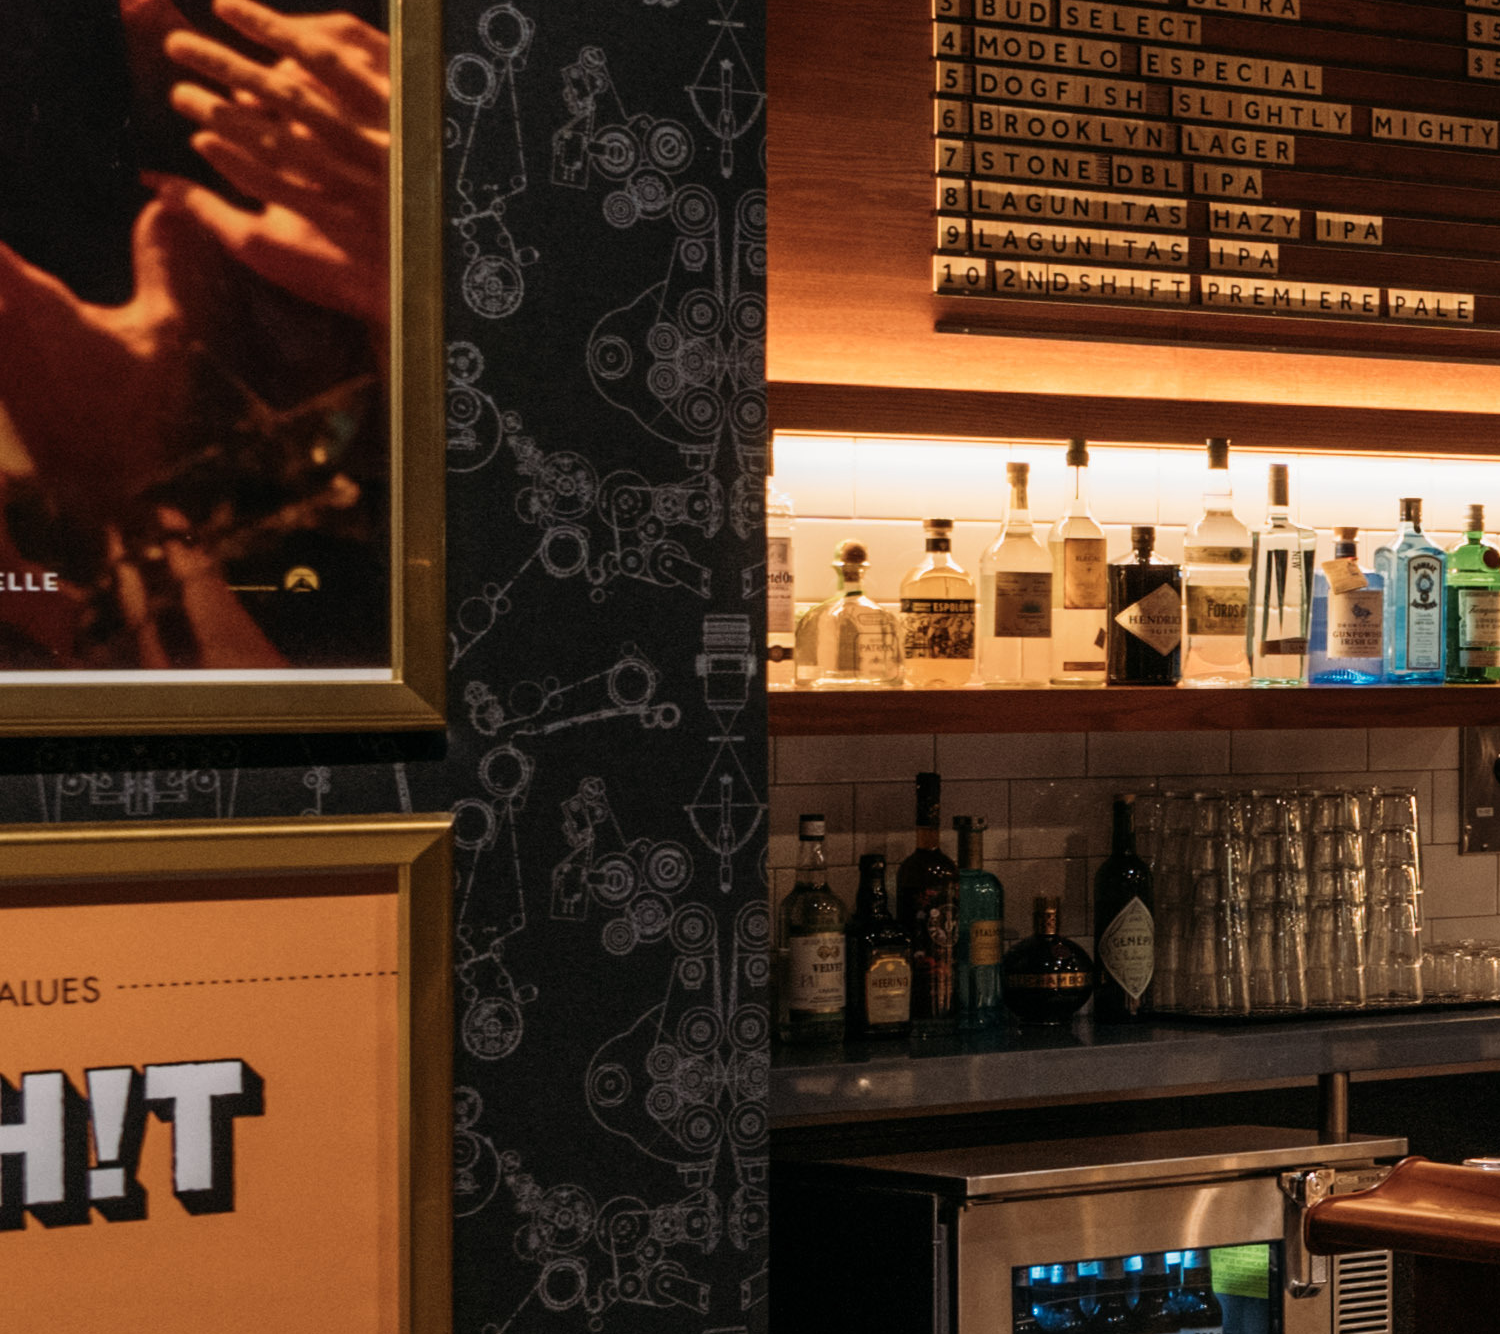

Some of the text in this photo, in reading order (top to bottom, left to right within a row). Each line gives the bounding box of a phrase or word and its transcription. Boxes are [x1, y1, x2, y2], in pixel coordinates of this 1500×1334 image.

[1066, 6, 1198, 39] SELECT
[941, 31, 956, 51] 4
[978, 35, 1119, 68] MODELO
[1146, 54, 1317, 91] ESPECIAL
[944, 69, 958, 89] 5
[980, 73, 1143, 109] DOGFISH
[1177, 93, 1349, 130] SLIGHTLY
[1374, 107, 1495, 145] MIGHTY
[943, 109, 956, 128] 6
[978, 111, 1163, 148] BROOKLYN
[1186, 132, 1290, 161] LAGER
[944, 147, 957, 168] 7
[981, 151, 1091, 180] STONE
[1116, 164, 1178, 188] DBL
[1202, 172, 1260, 196] IPA
[944, 187, 958, 207] 8
[977, 188, 1182, 225] LAGUNITAS
[1213, 209, 1296, 236] HAZY
[1325, 218, 1380, 242] IPA
[946, 225, 960, 245] 9
[978, 227, 1184, 262] LAGUNITAS
[1217, 245, 1275, 269] IPA
[943, 263, 980, 287] 10
[1002, 267, 1186, 300] 2NDSHIFT
[1206, 281, 1375, 314] PREMIERE
[1393, 294, 1471, 320] PALE
[1206, 602, 1238, 620] FORDS
[0, 976, 101, 1007] ALUES
[871, 976, 909, 988] HEERING
